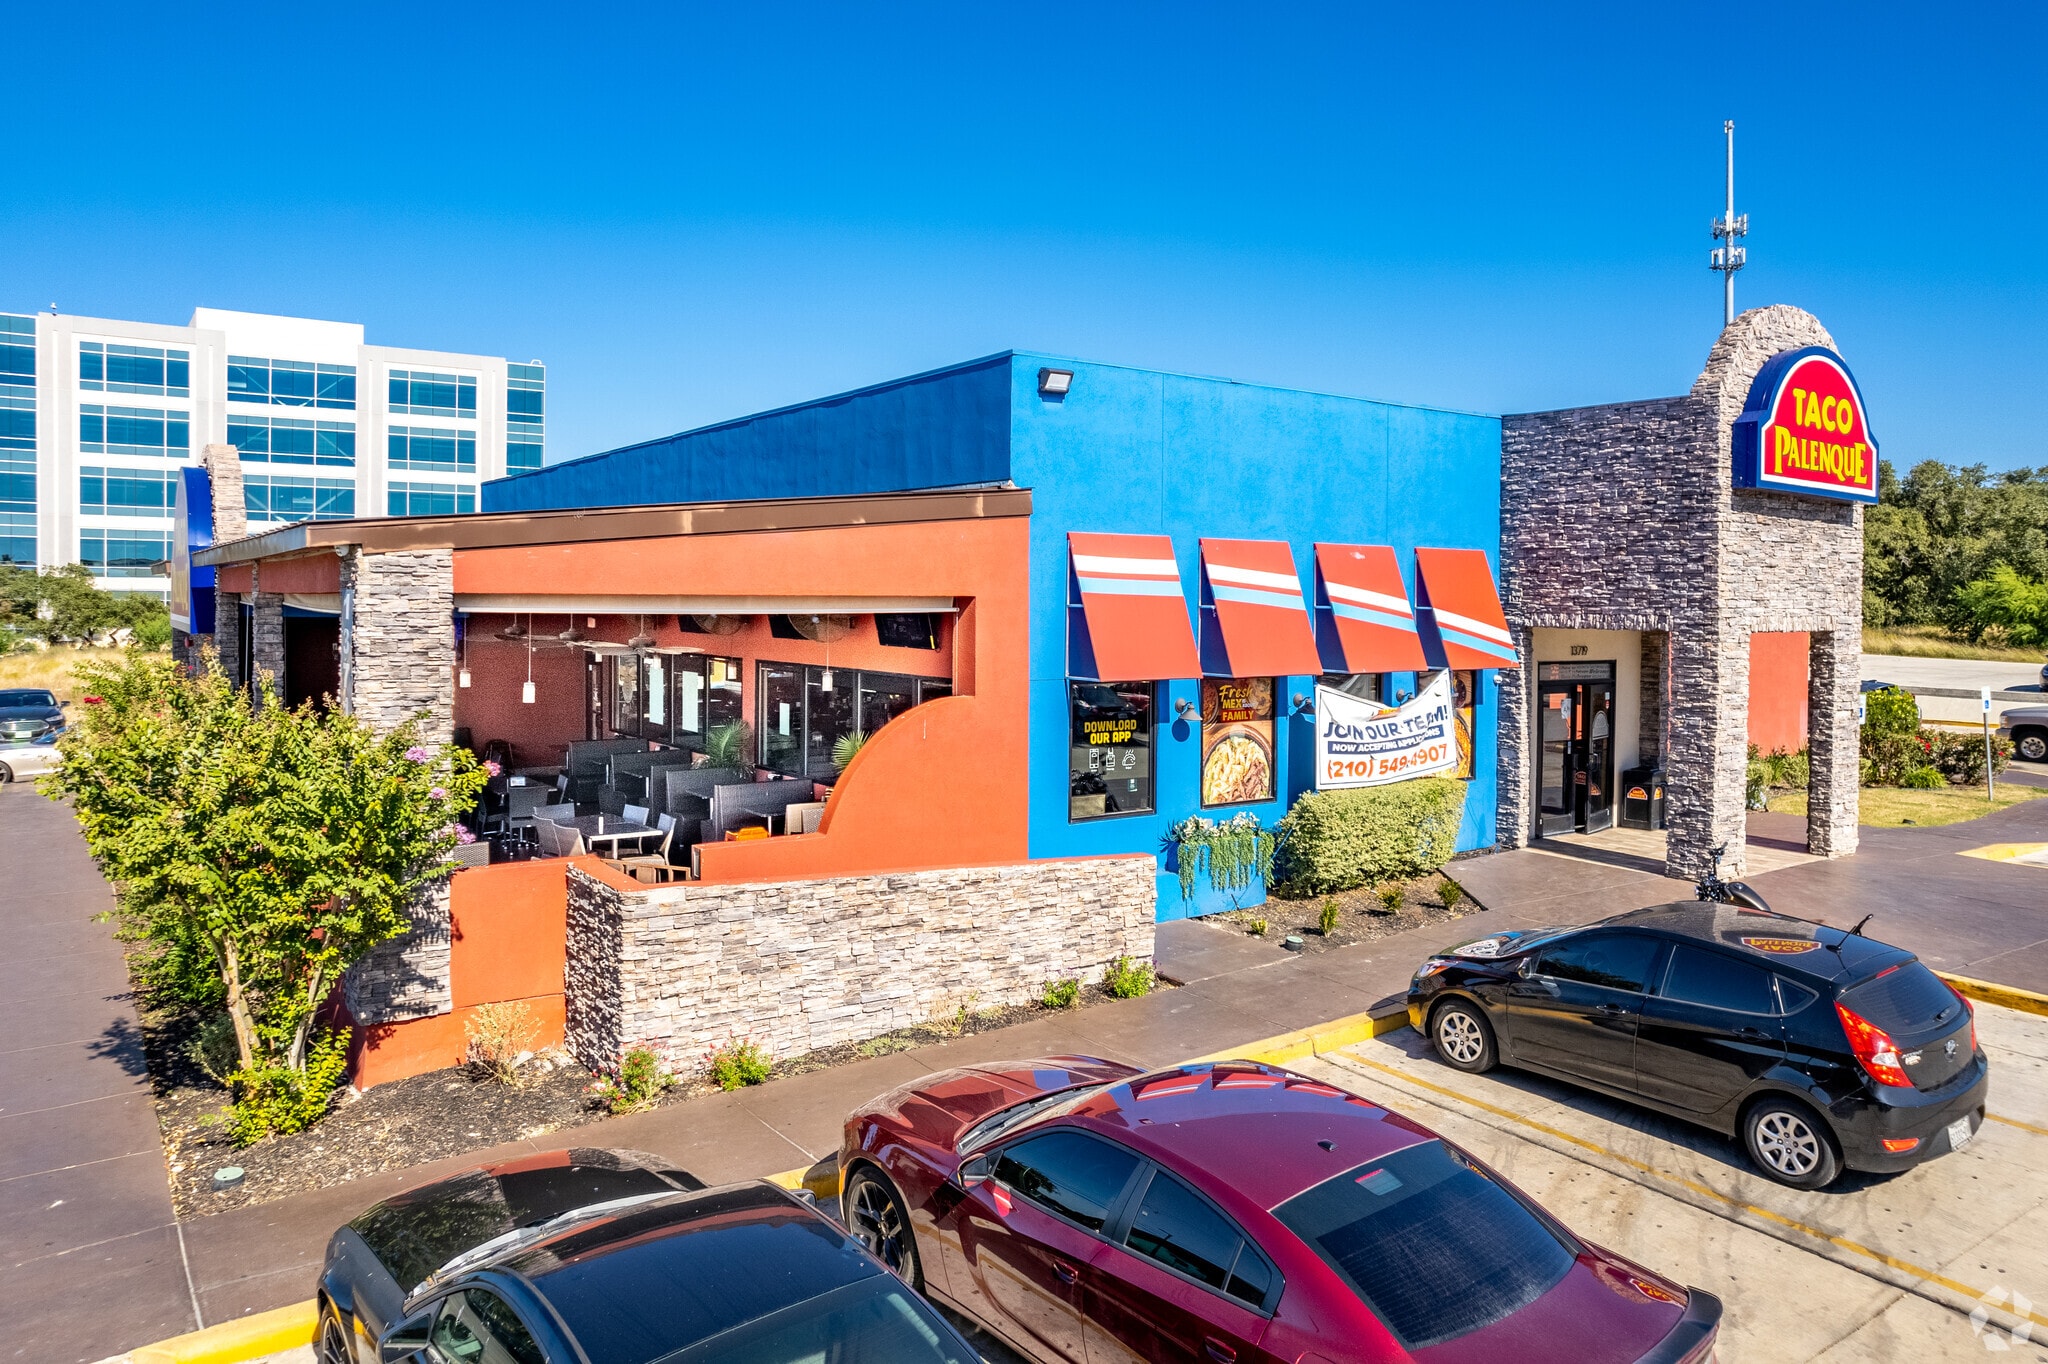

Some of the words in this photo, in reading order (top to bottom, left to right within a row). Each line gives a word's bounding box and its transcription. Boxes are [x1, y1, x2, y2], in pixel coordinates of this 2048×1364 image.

[1793, 388, 1853, 435] TACO
[1774, 425, 1868, 485] PALENQUE
[1222, 699, 1242, 709] MEX
[1222, 710, 1254, 721] FAMILY
[1084, 719, 1137, 733] DOWNLOAD
[1323, 721, 1364, 740] JOIN
[1365, 722, 1402, 740] OUR
[1090, 732, 1110, 745] OUR
[1112, 731, 1131, 743] APP
[1332, 743, 1357, 752] NOW
[1358, 741, 1397, 752] ACCEPTING
[1327, 759, 1374, 779] (210)
